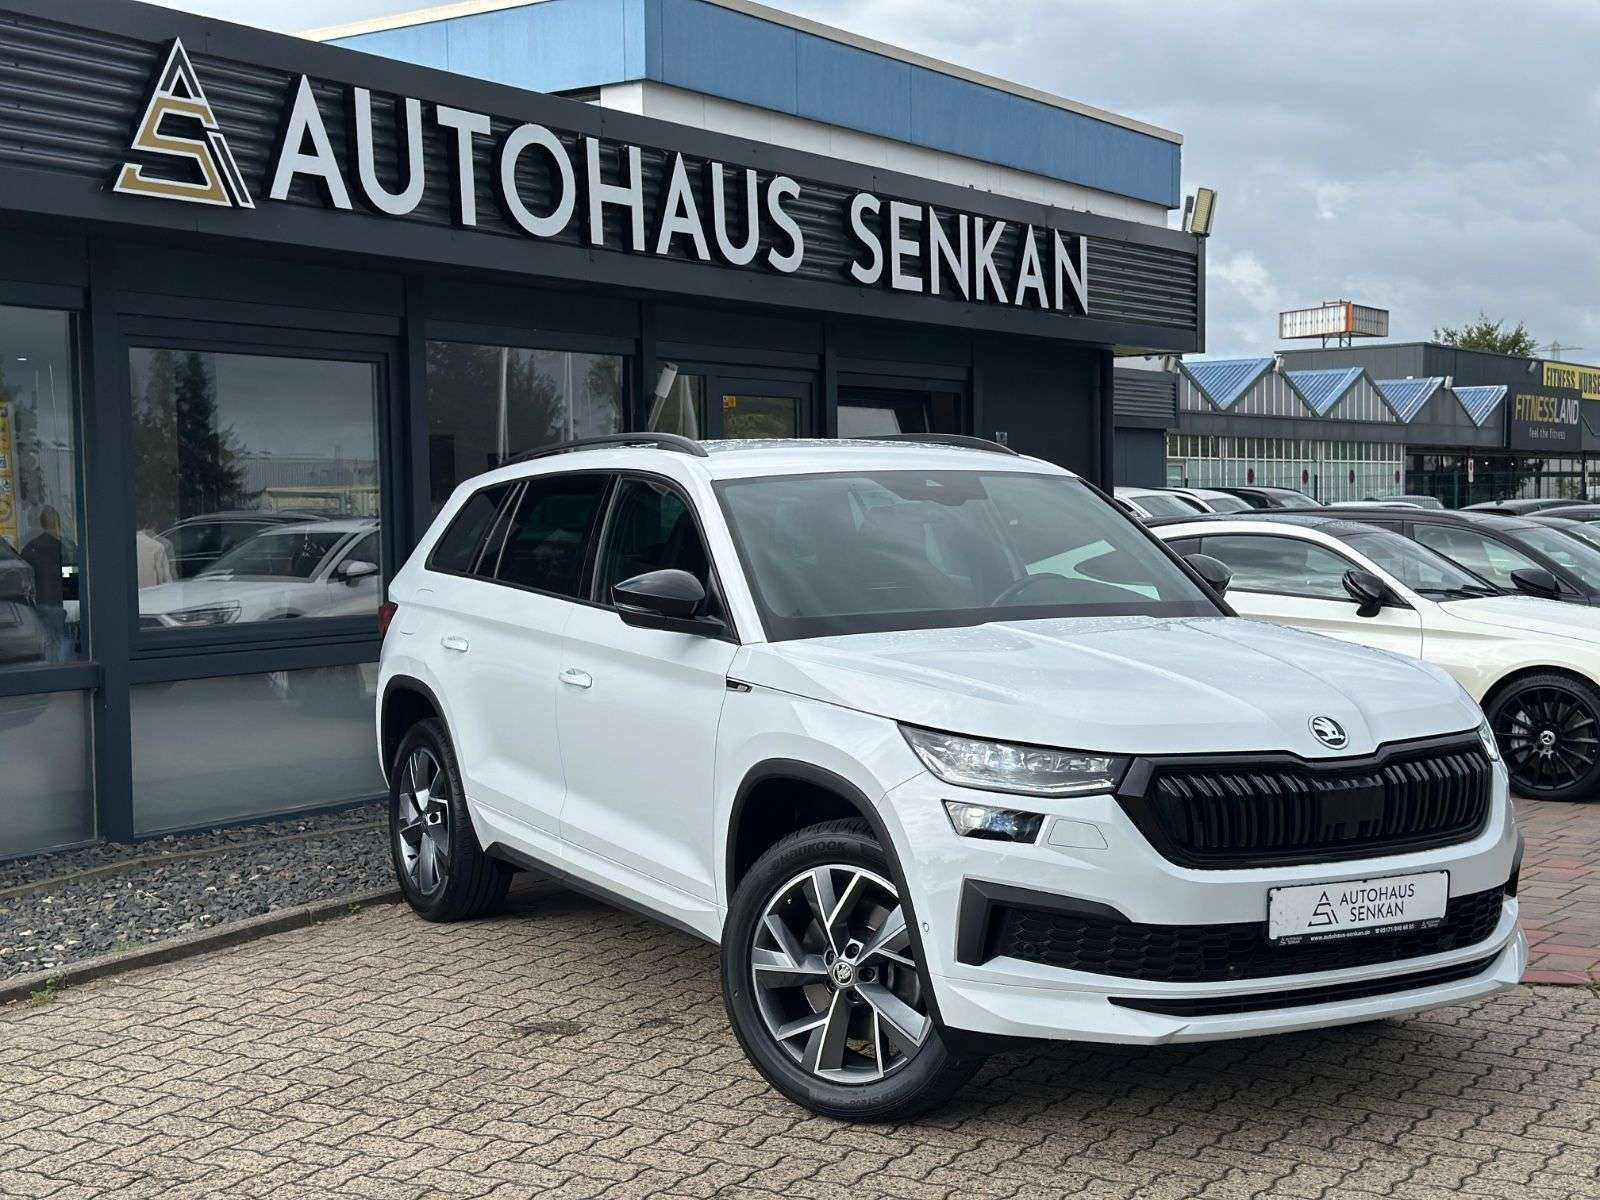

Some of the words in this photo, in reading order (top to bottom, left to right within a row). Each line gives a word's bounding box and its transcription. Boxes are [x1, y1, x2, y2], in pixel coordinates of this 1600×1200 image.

[269, 74, 804, 273] AUTOHAUS
[850, 192, 1088, 316] SENKAN
[1515, 394, 1579, 425] FITNESSLAND
[1340, 883, 1415, 906] AUTOHAUS
[1350, 901, 1404, 922] SENKAN
